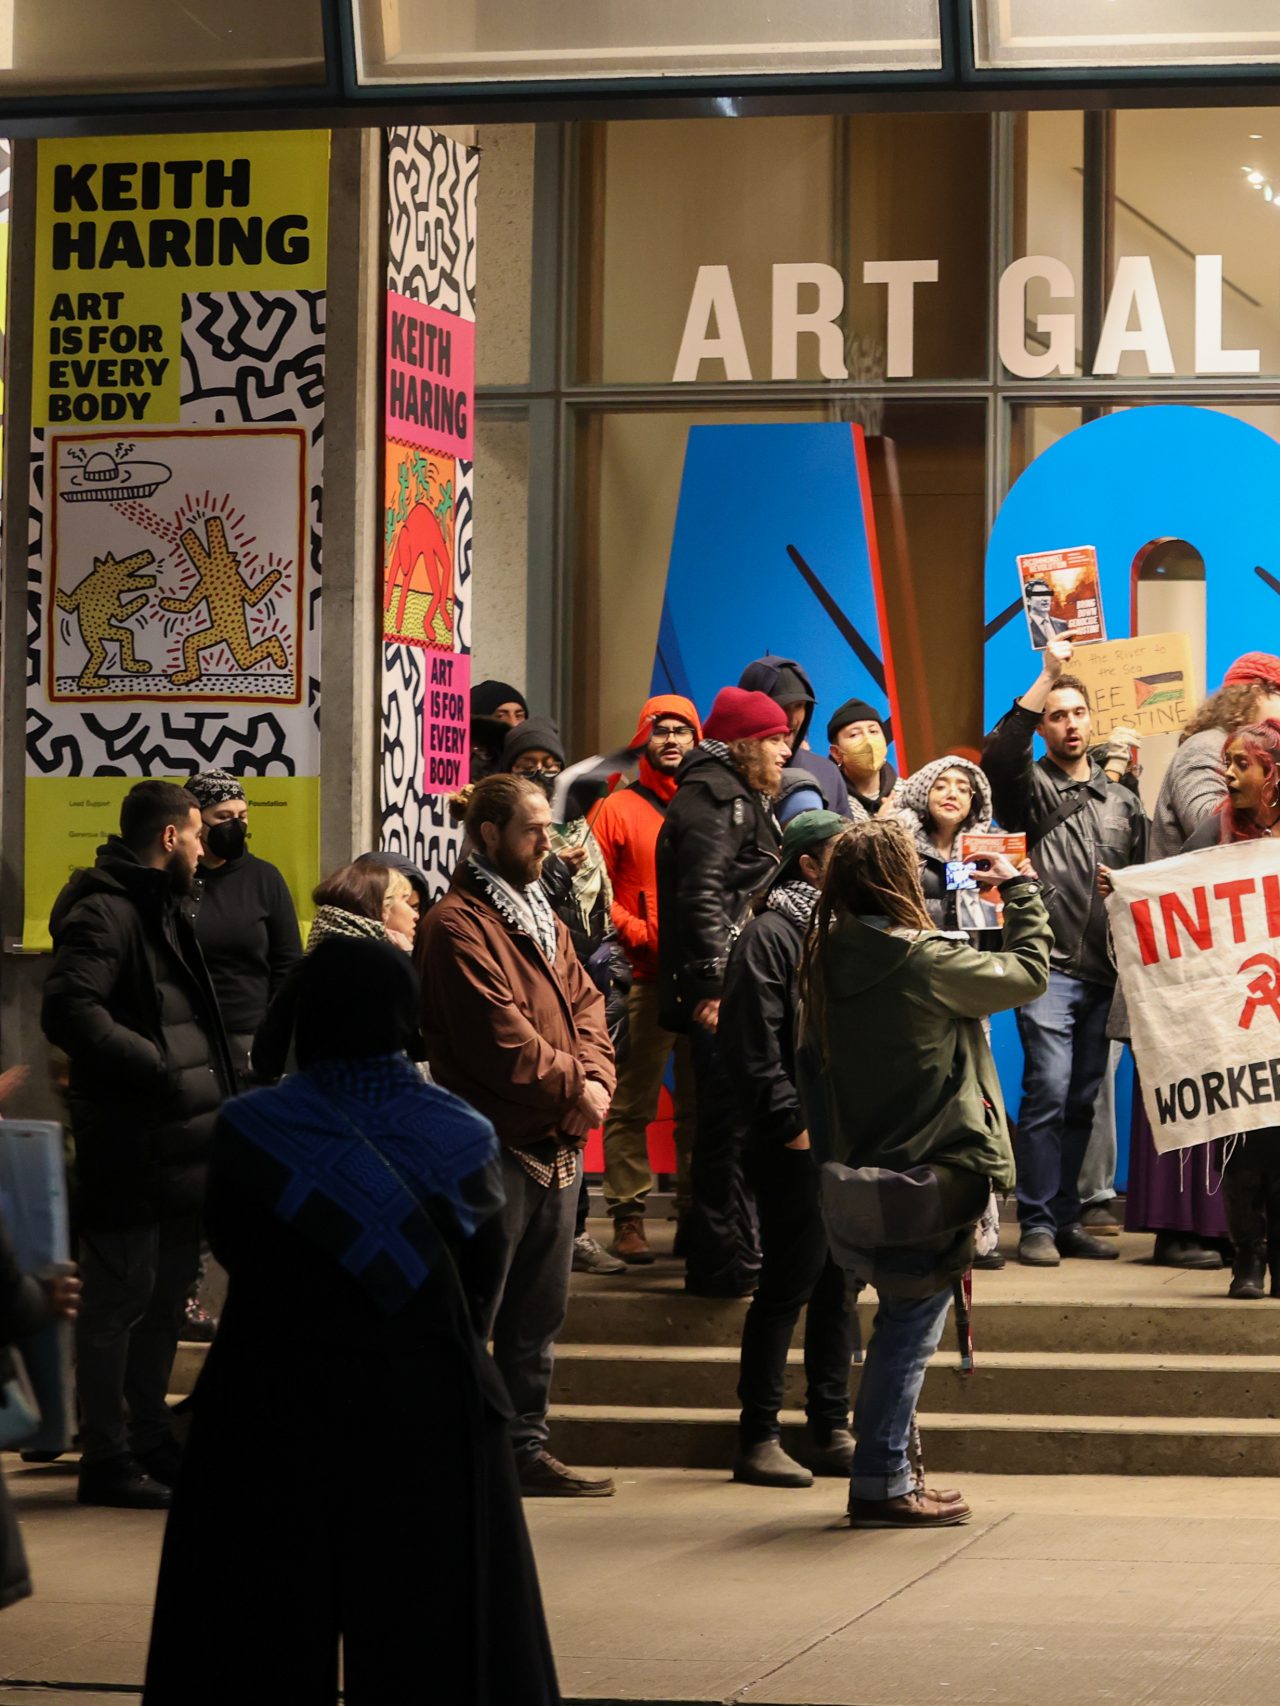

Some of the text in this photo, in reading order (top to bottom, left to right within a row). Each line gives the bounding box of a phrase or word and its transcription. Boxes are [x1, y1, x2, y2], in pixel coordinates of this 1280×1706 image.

[54, 159, 250, 212] KEITH
[52, 214, 310, 270] HARING
[50, 291, 125, 321] ART
[672, 258, 939, 382] ART
[49, 324, 163, 355] IS FOR
[391, 310, 451, 378] KEITH
[49, 358, 170, 388] EVERY
[48, 392, 151, 423] BODY
[390, 368, 467, 440] HARING
[1115, 647, 1146, 661] River
[1122, 664, 1143, 675] Sea
[431, 657, 453, 687] ART
[431, 690, 464, 722] IS FOR
[1094, 686, 1126, 713] EE
[1091, 701, 1189, 737] LESTINE
[430, 723, 466, 755] EVERY
[430, 756, 461, 787] BODY
